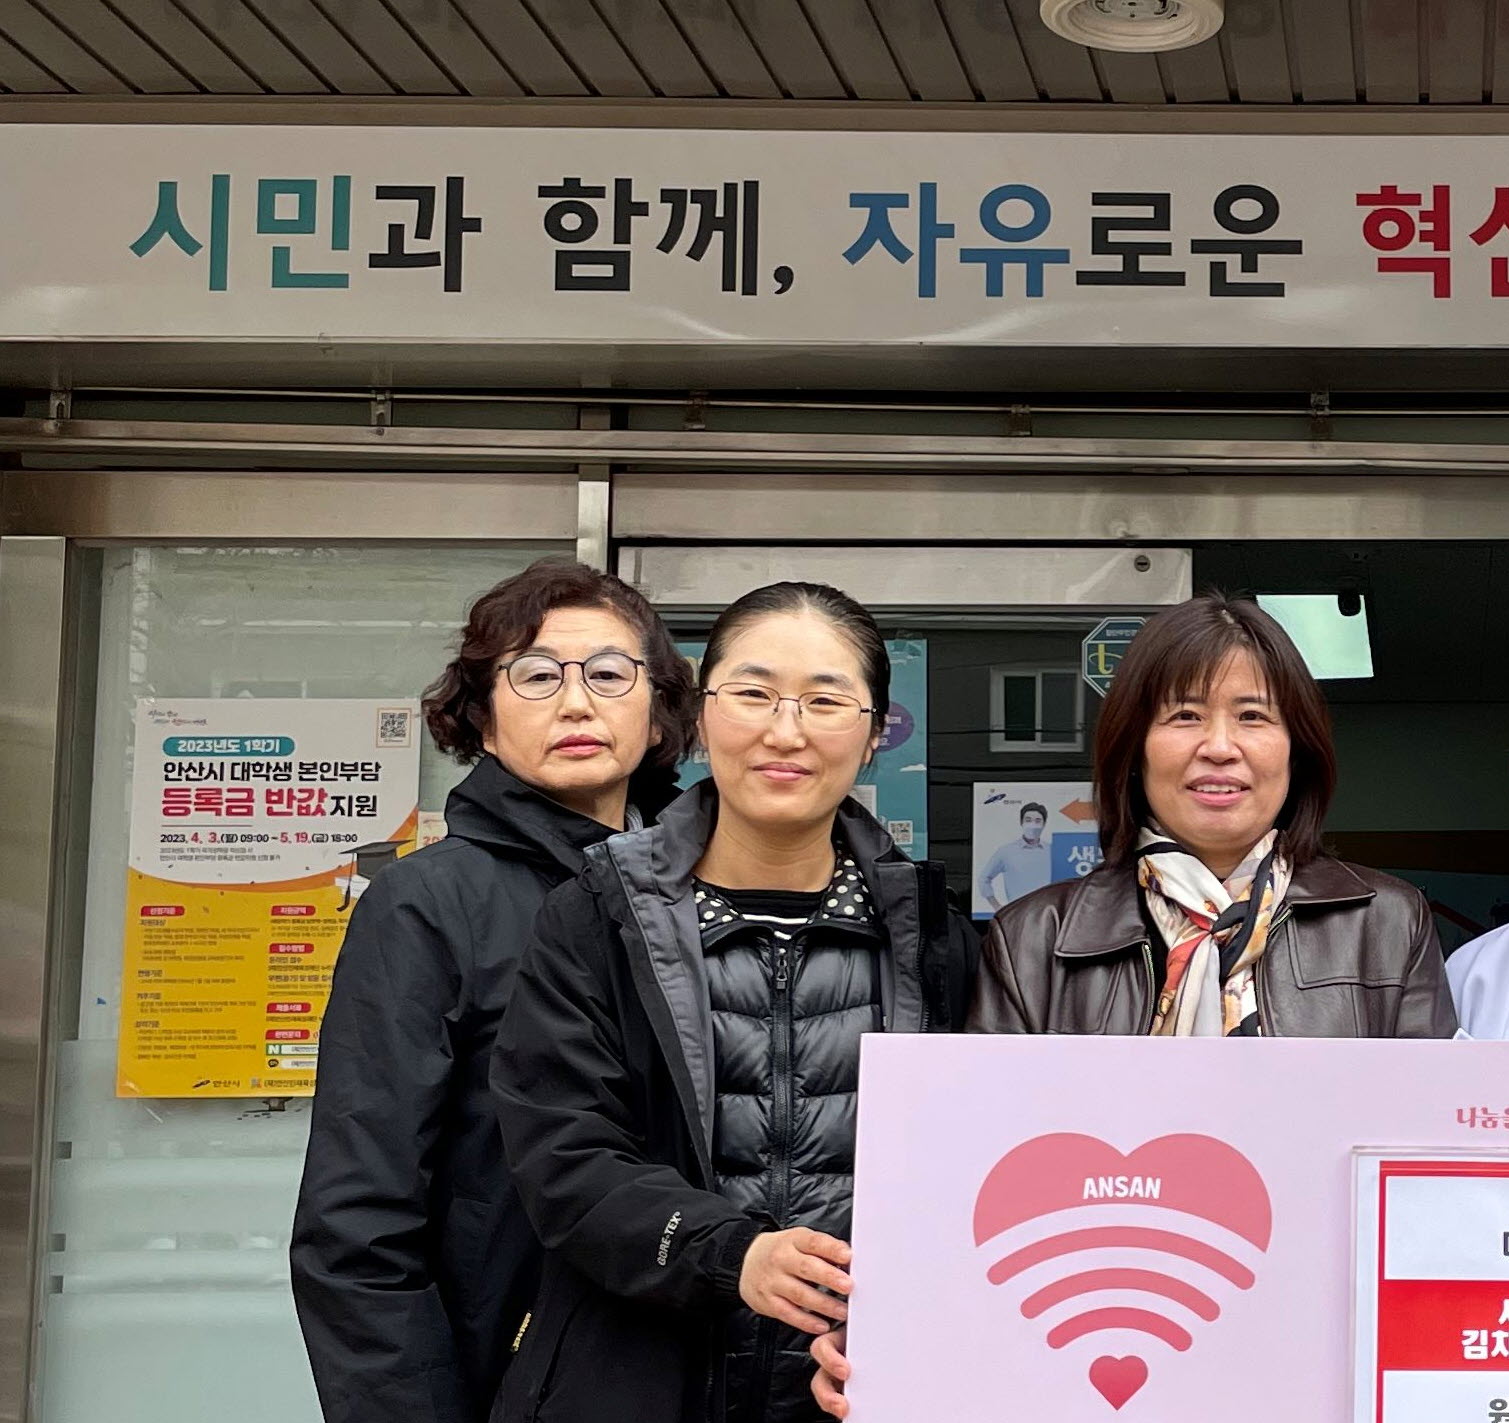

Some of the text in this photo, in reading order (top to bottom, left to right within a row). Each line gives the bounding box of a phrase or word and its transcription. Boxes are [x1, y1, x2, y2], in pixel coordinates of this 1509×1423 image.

[130, 174, 481, 292] 시민과
[537, 176, 794, 296] 함께,
[842, 182, 1302, 298] 자유로운
[178, 739, 280, 753] 2023년도 1학기
[163, 762, 381, 781] 안산시 대학생 본인부담
[162, 788, 254, 816] 등록금
[1083, 1176, 1161, 1199] ANSAN
